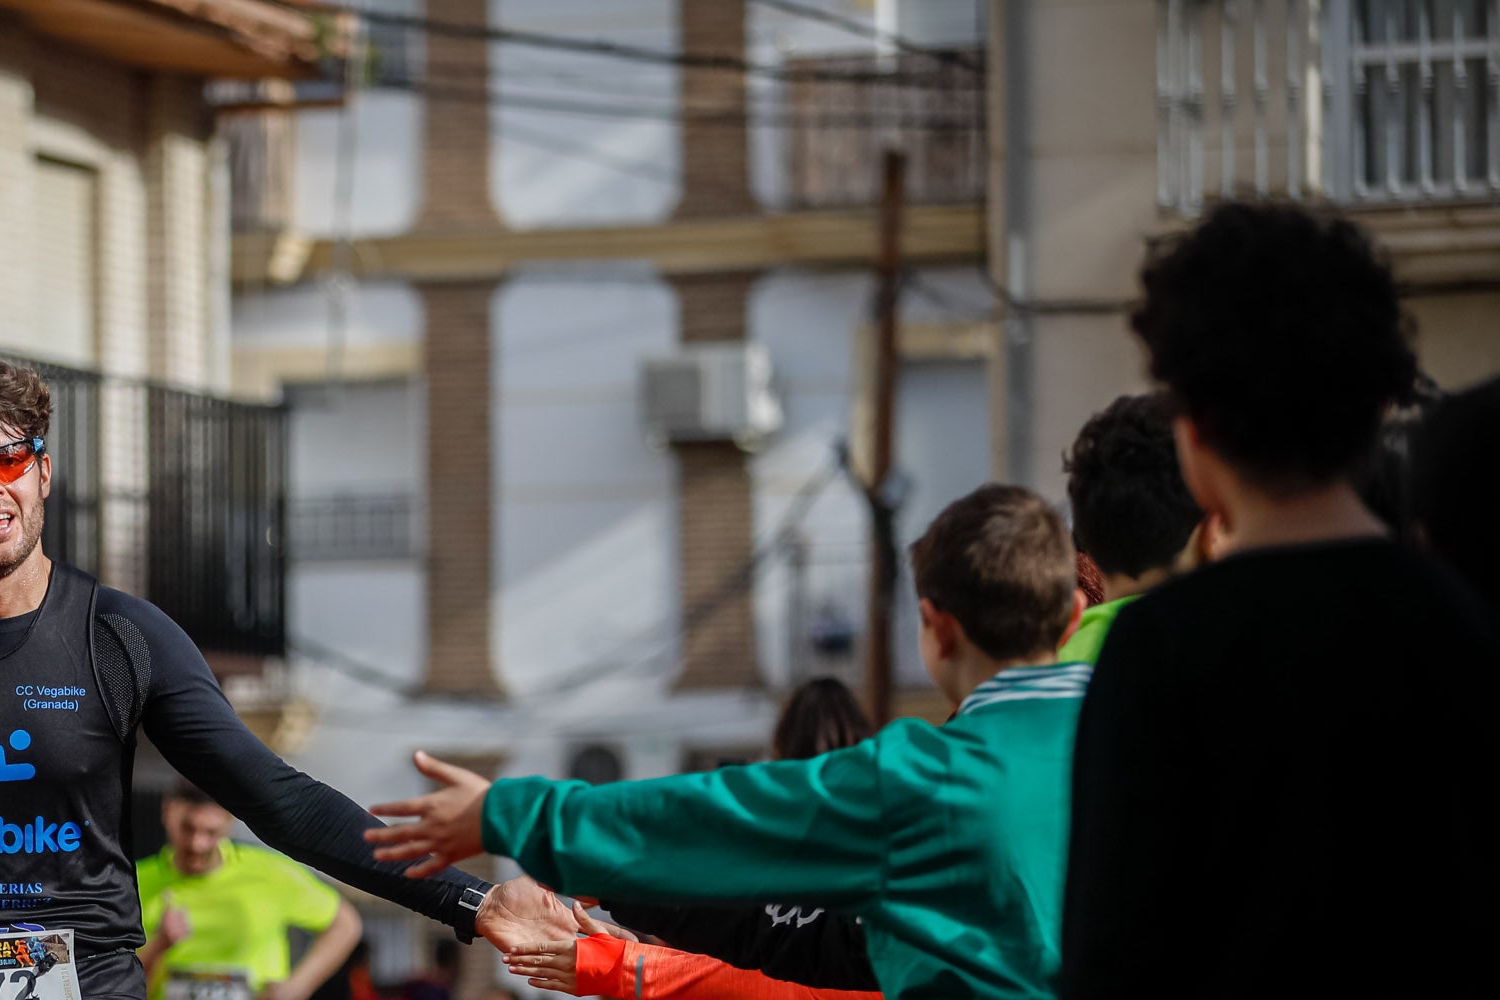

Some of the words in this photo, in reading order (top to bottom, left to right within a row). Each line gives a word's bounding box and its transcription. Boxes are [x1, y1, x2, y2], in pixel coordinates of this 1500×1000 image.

[15, 685, 34, 696] CC
[36, 685, 86, 698] Vegabike
[23, 699, 79, 711] (Granada)
